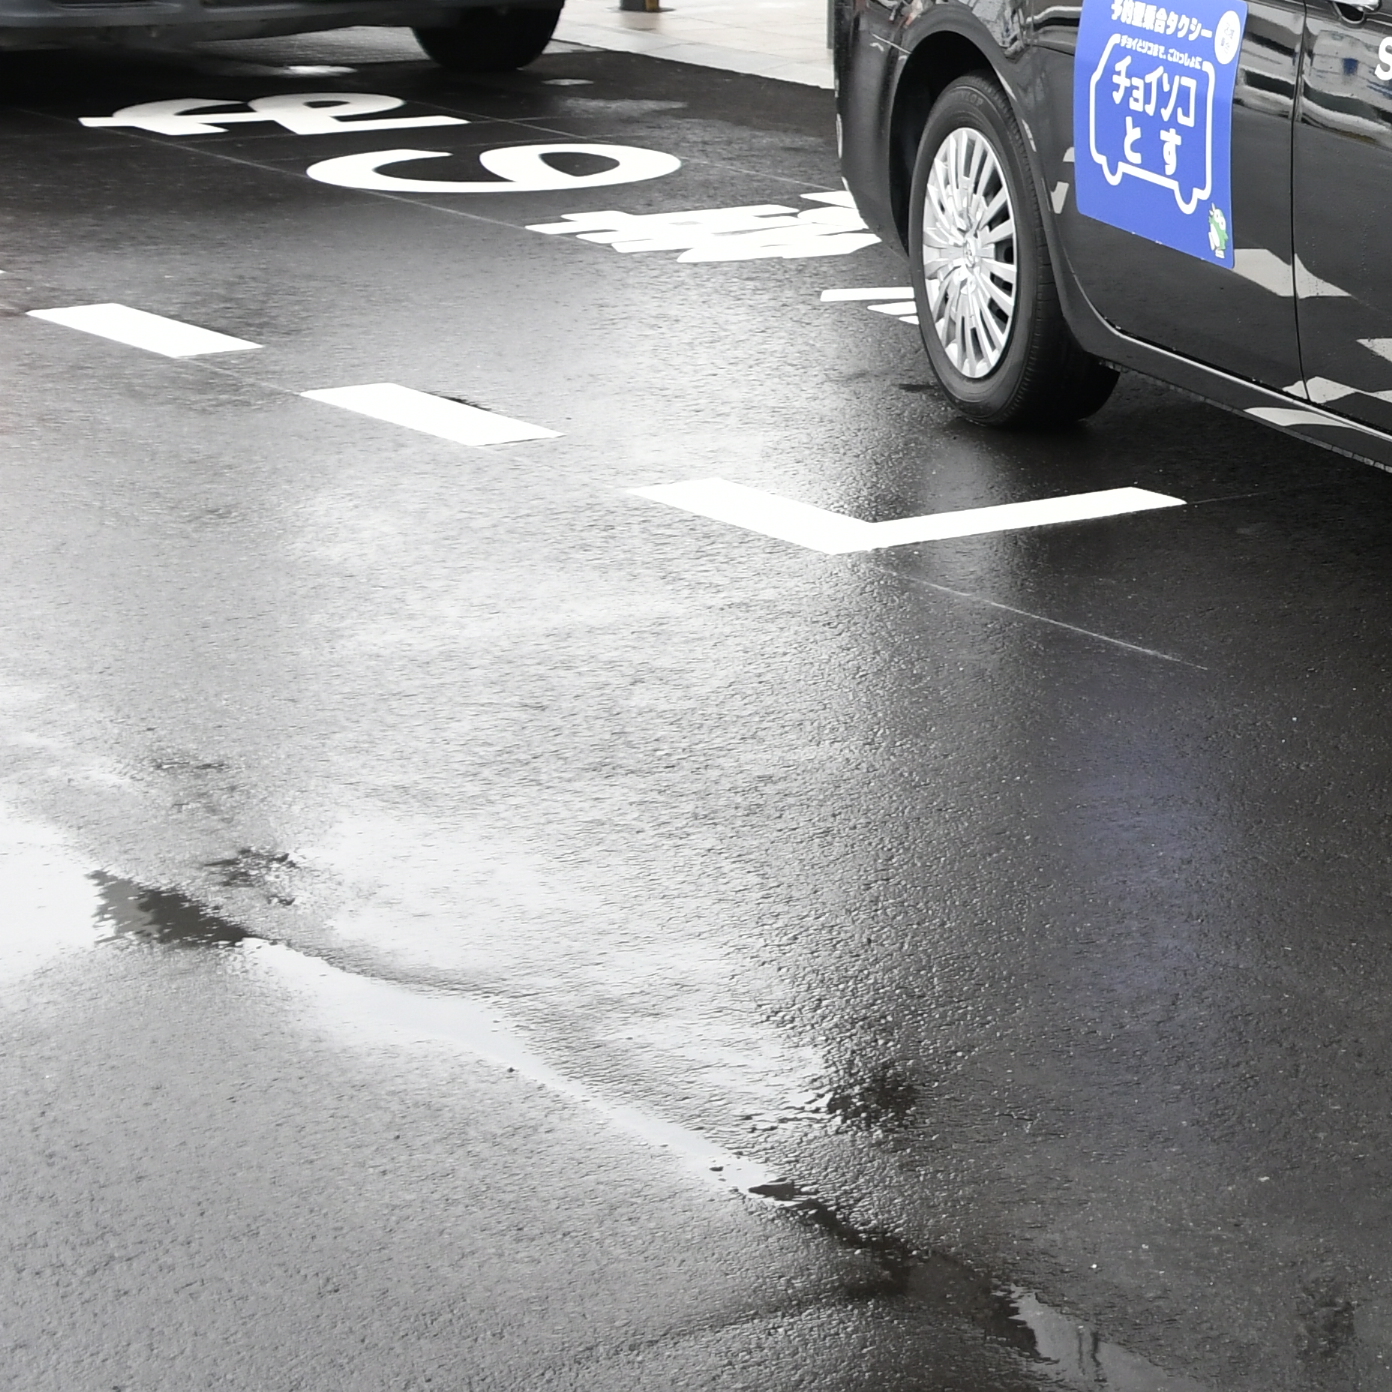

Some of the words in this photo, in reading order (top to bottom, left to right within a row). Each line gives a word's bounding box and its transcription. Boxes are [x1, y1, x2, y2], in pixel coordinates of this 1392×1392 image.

[1112, 55, 1197, 128] チョイソコ
[1123, 116, 1182, 176] とす
